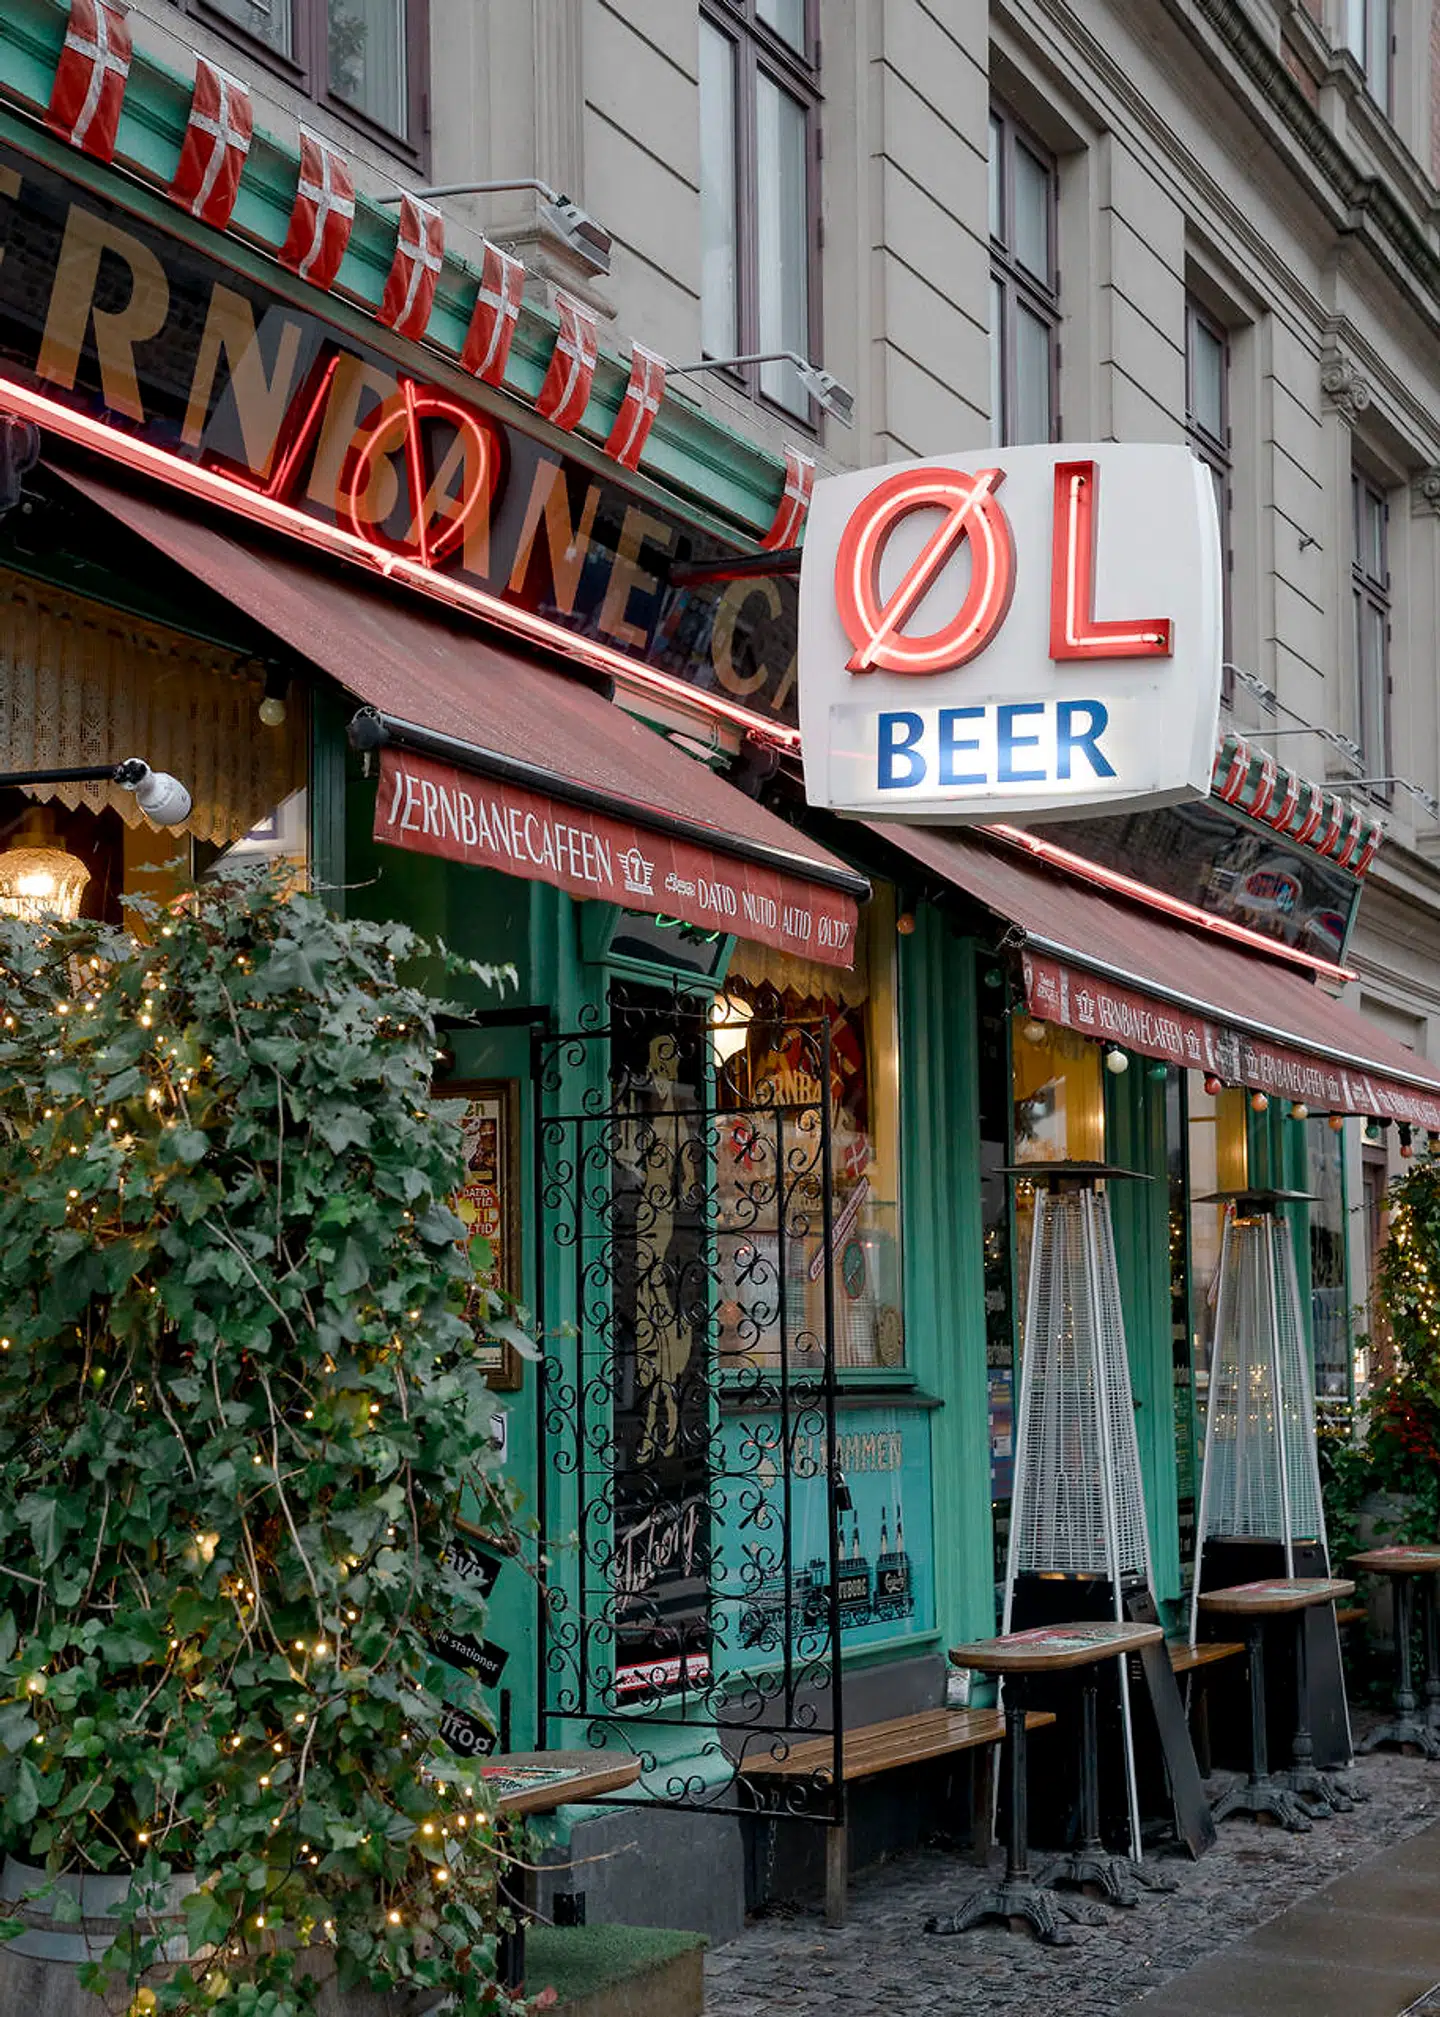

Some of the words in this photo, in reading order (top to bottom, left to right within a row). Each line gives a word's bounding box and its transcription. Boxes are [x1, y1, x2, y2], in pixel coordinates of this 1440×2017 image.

[834, 460, 1174, 676] ØL
[877, 700, 1118, 790] BEER
[388, 771, 614, 887] JERNBANECAFEEN
[698, 878, 737, 917] DATID
[743, 893, 778, 931] NUTID
[783, 906, 813, 943] ALTID
[450, 1635, 499, 1673] stationer
